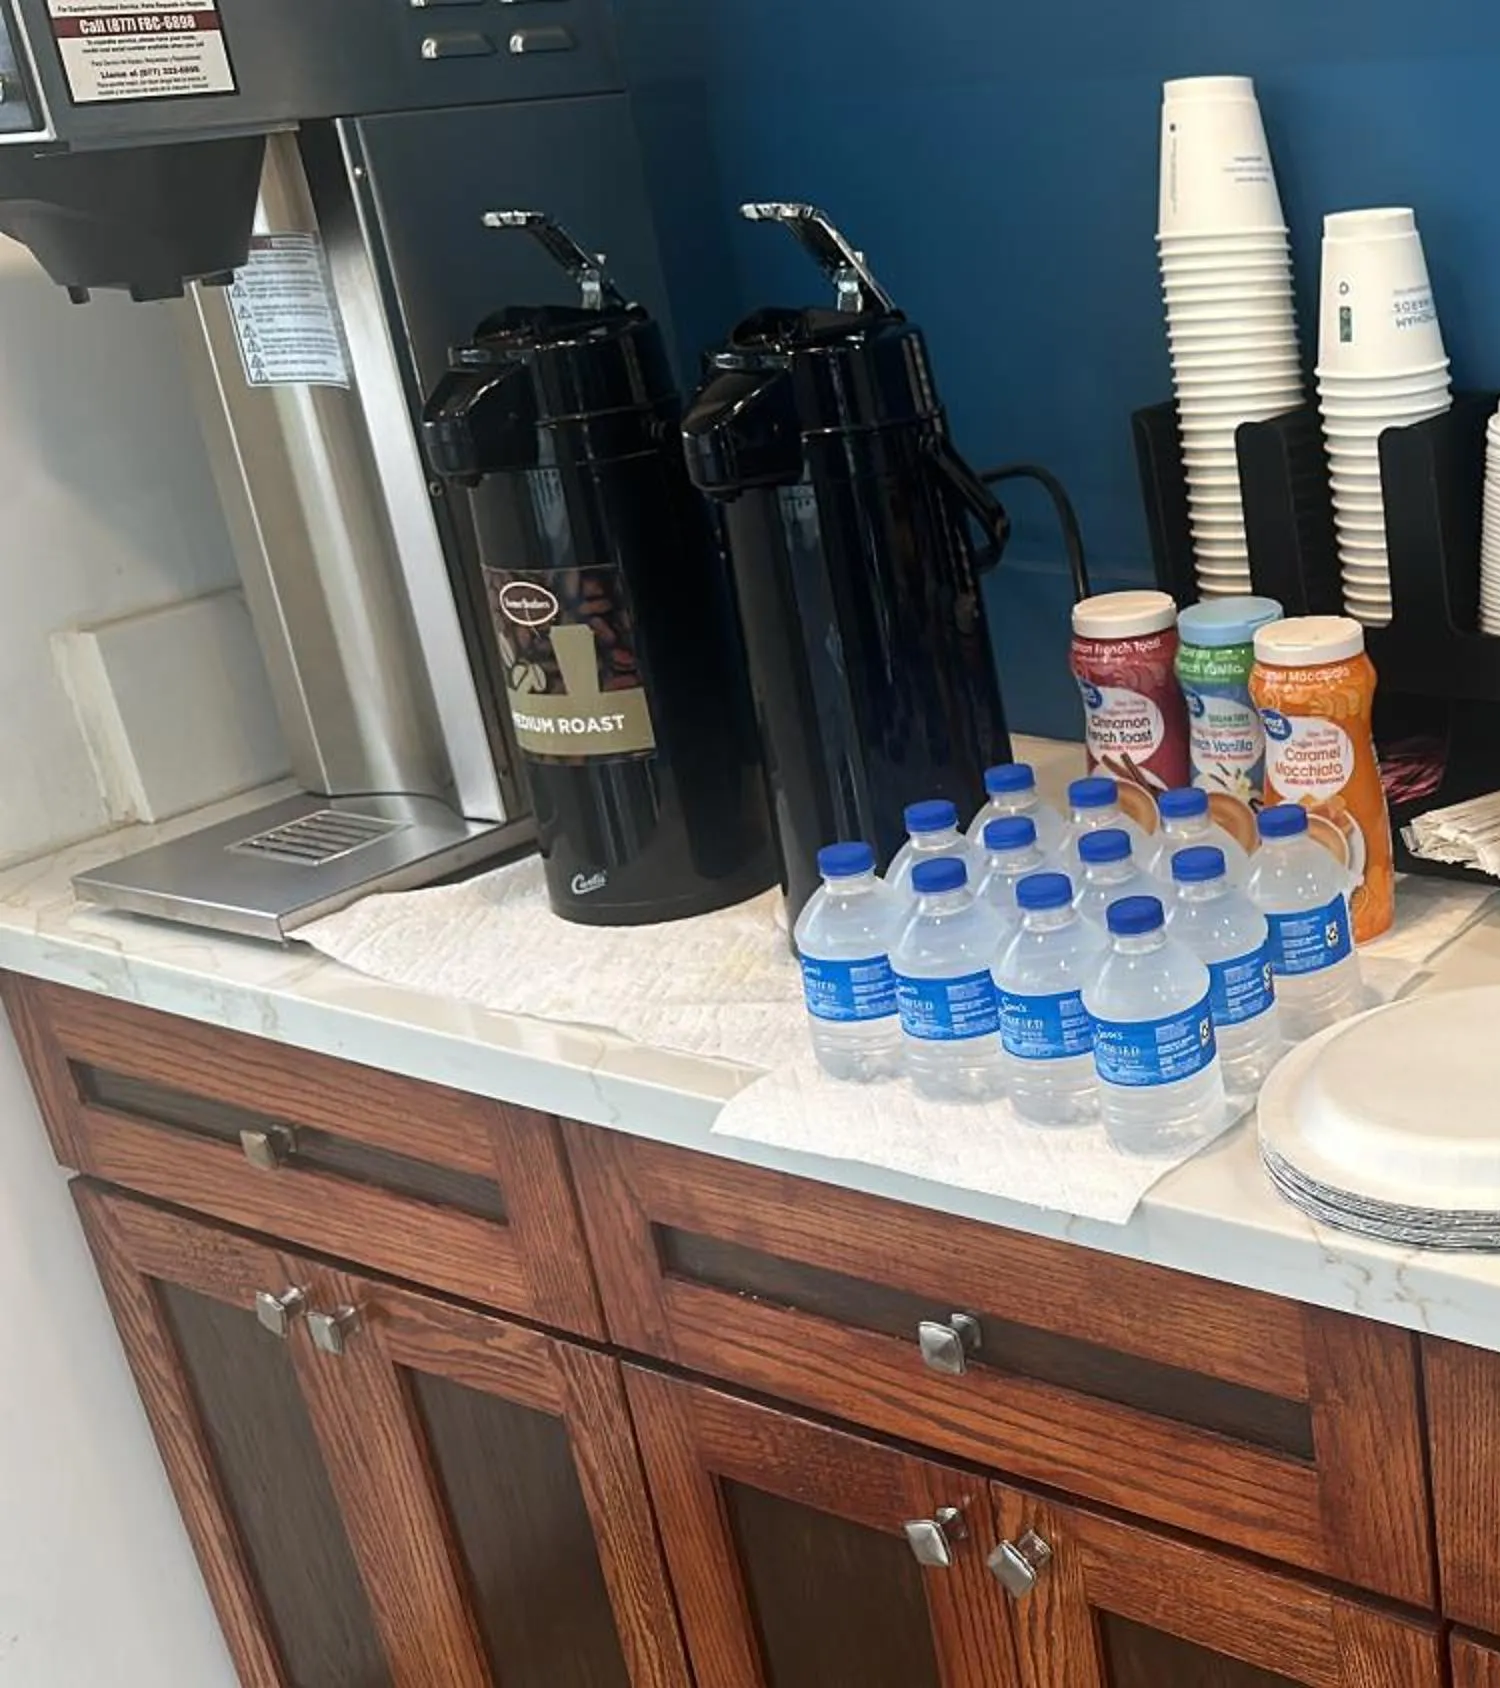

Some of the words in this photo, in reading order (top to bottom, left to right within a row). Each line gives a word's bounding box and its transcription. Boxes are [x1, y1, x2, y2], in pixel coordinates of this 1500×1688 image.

[79, 18, 106, 34] Call
[106, 16, 136, 33] (877)
[137, 15, 196, 32] FBC-6898
[558, 714, 625, 734] ROAST
[1119, 730, 1152, 744] Toast
[1211, 738, 1253, 753] Vanilla
[1284, 745, 1341, 762] Caramel
[1275, 761, 1344, 778] Macchiato
[1096, 1022, 1123, 1041] Sam's
